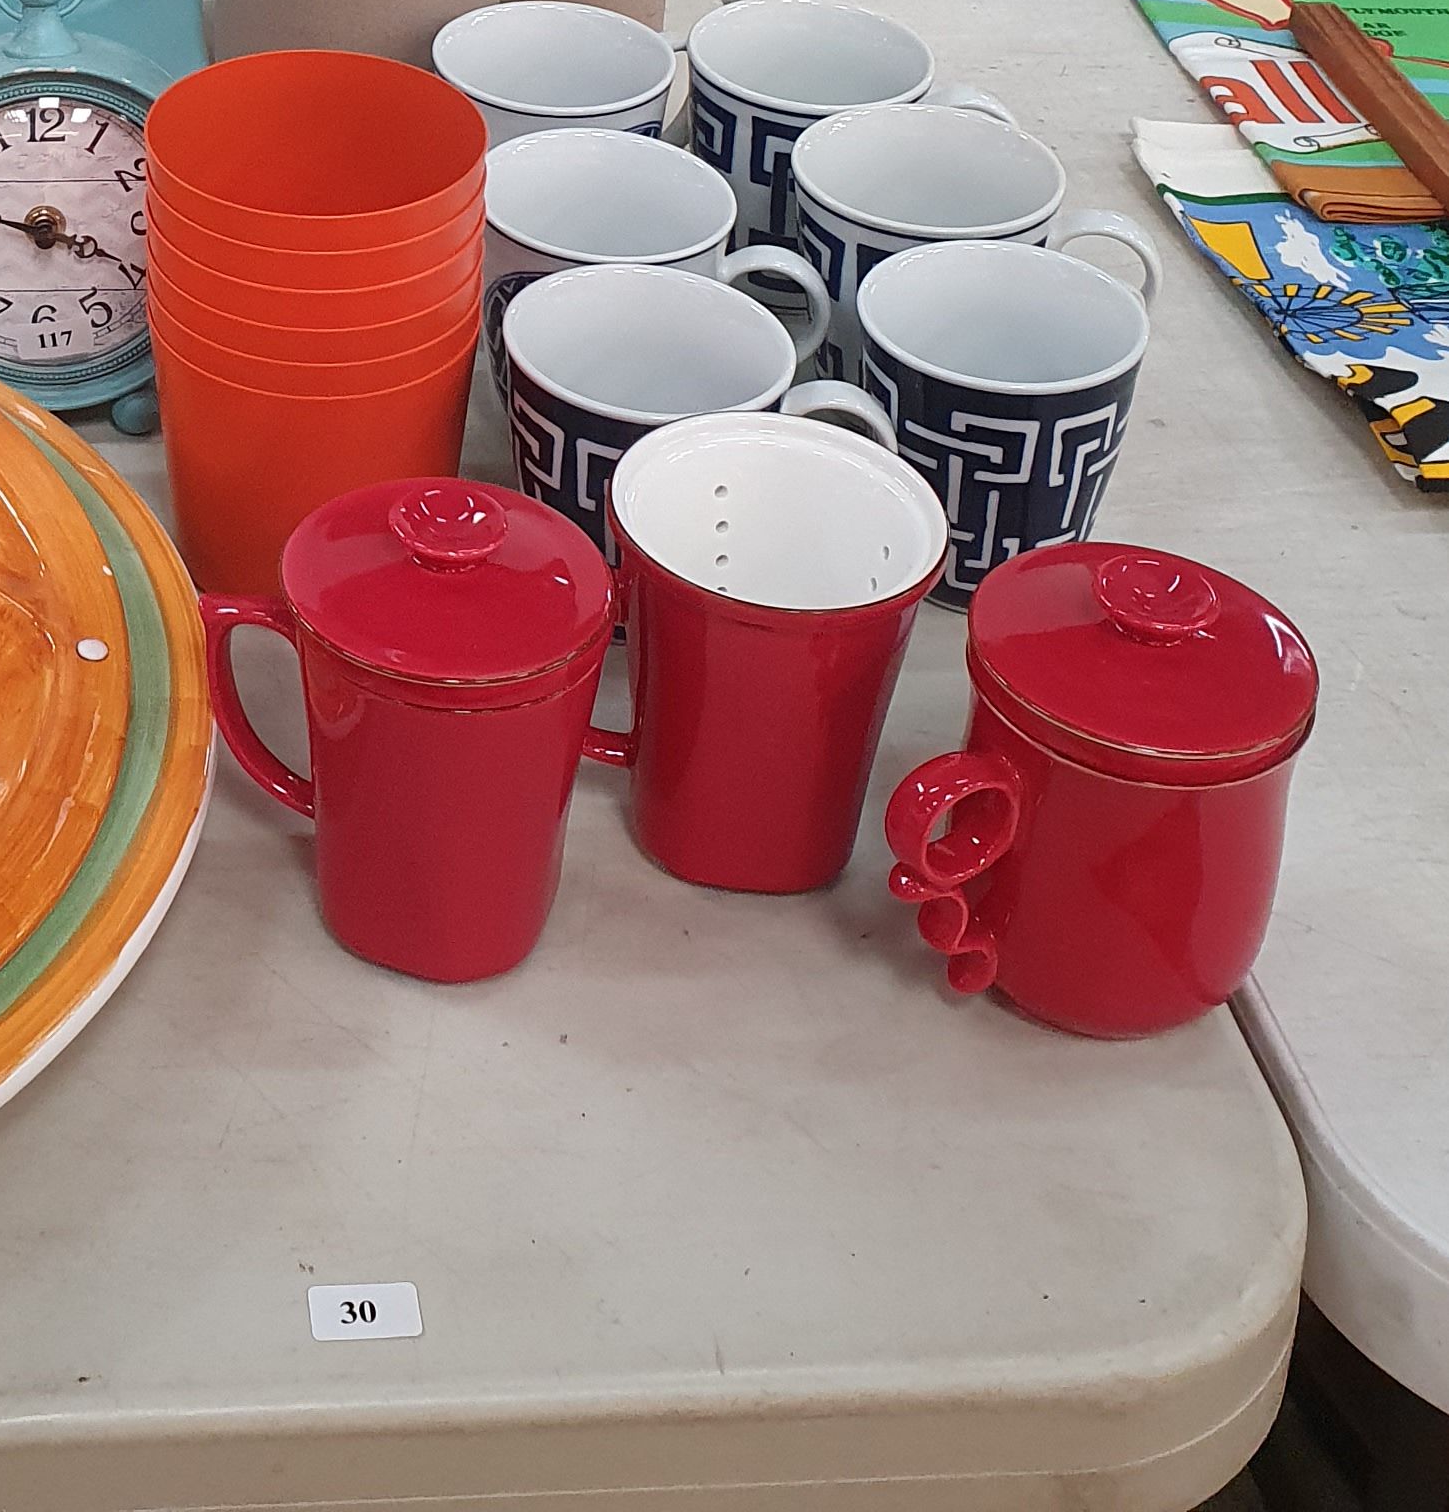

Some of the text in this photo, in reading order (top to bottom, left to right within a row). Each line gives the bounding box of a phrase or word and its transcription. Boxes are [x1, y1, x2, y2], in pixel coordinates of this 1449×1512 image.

[26, 107, 66, 143] 12
[84, 119, 109, 155] 1
[113, 158, 146, 193] 2
[78, 286, 113, 329] 5
[38, 330, 72, 349] 117
[339, 1299, 378, 1325] 30
